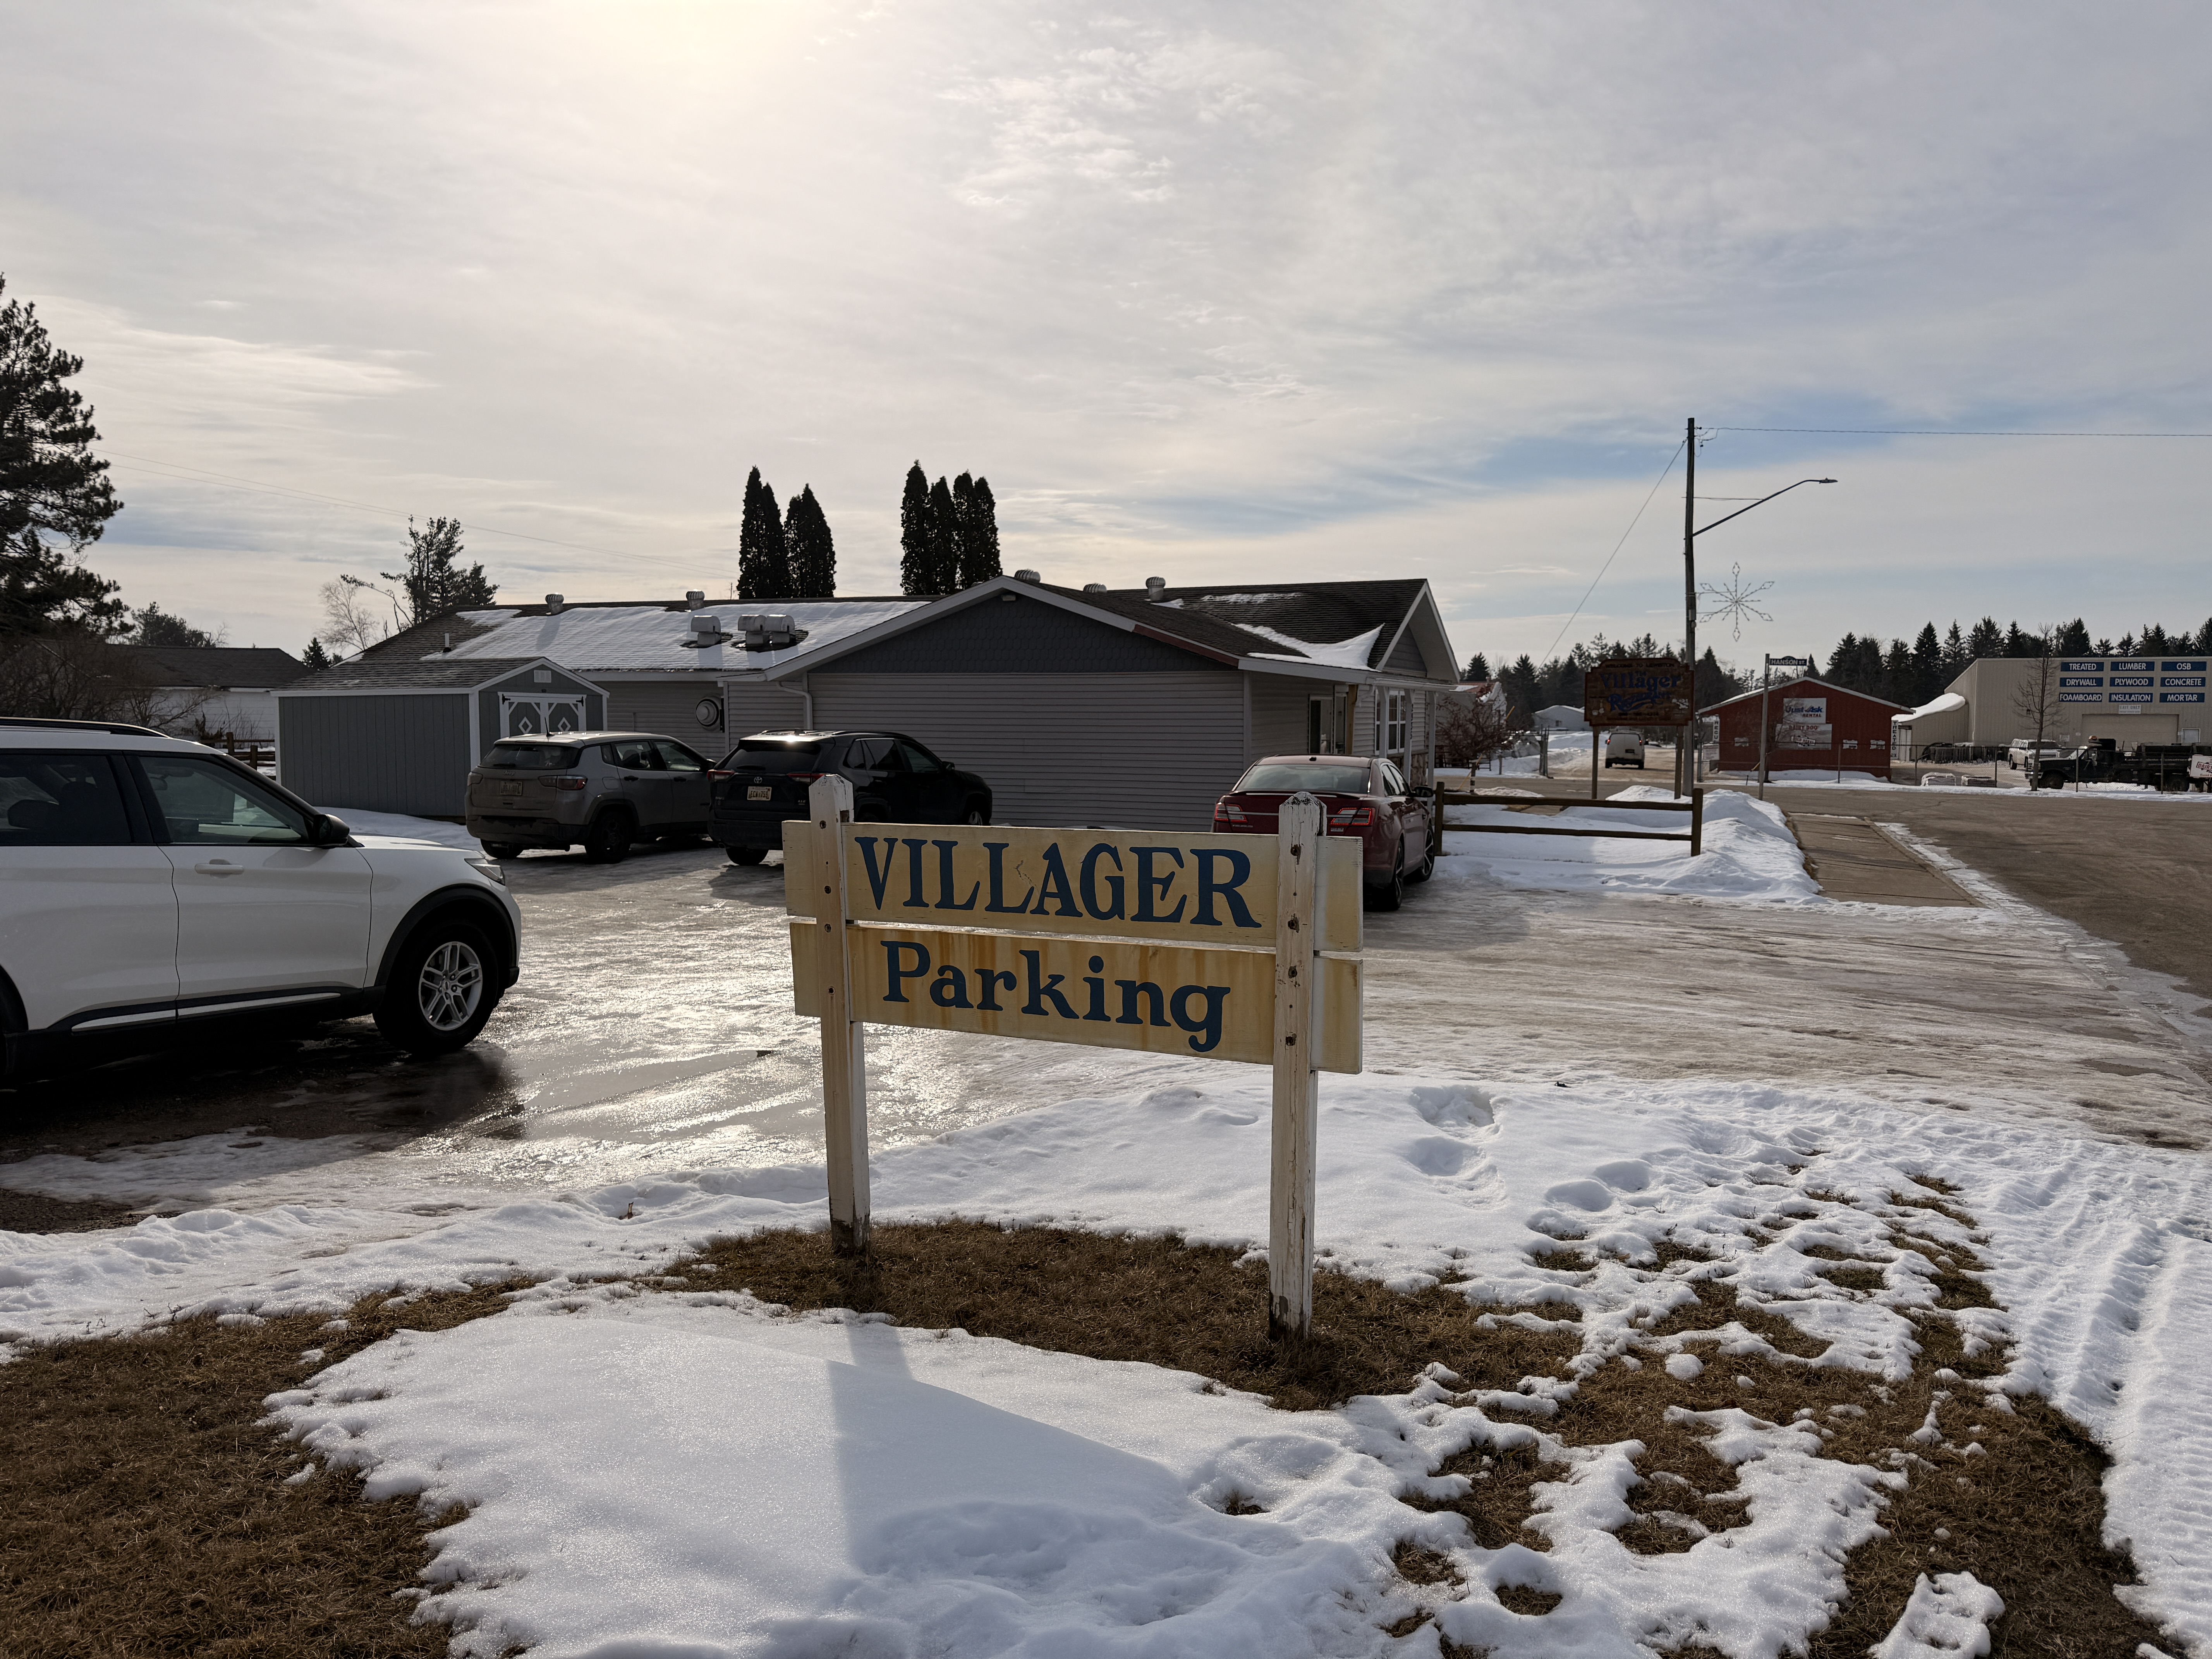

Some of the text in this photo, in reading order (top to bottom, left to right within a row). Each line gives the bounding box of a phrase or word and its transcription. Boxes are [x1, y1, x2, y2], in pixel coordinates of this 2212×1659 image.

[1600, 672, 1682, 694] Villager
[854, 836, 1262, 928] VILLAGER
[880, 941, 1231, 1053] Parking
